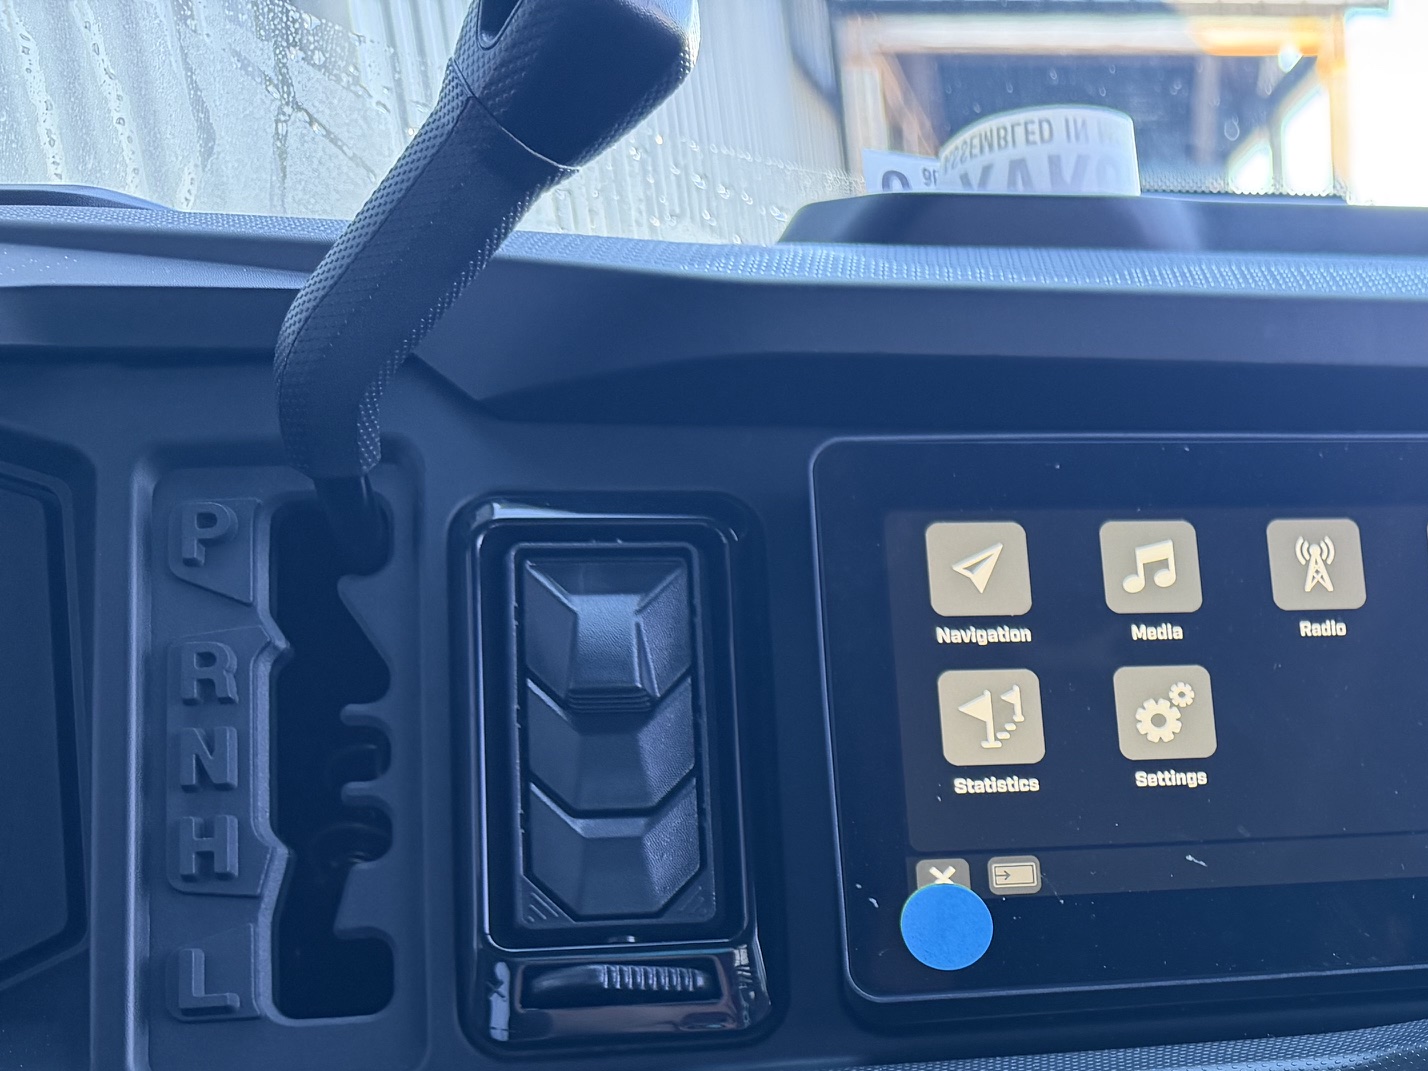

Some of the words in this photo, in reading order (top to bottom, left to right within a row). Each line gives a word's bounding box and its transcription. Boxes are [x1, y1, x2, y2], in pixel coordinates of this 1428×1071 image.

[181, 502, 238, 566] P
[936, 625, 1032, 646] Navigation
[1131, 623, 1183, 641] Media
[1299, 620, 1346, 638] Radio
[180, 641, 239, 705] R
[179, 726, 238, 791] N
[1135, 770, 1207, 788] Settings
[954, 776, 1039, 794] Statistics
[179, 814, 238, 879] H
[178, 948, 240, 1009] L
